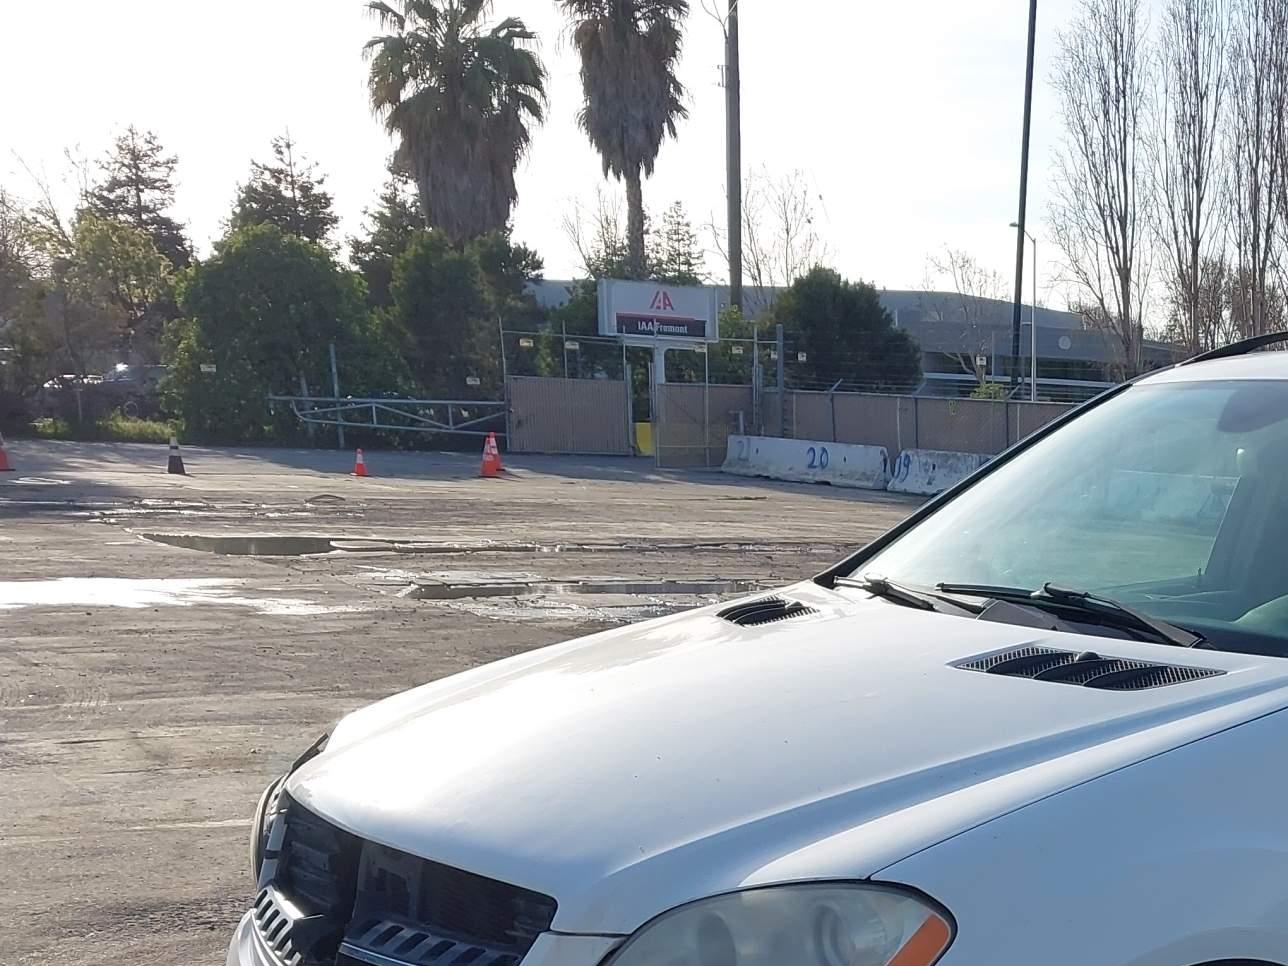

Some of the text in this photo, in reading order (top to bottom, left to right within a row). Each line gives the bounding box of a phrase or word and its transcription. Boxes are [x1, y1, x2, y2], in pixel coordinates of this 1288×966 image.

[638, 320, 688, 335] IAA Fremont
[806, 446, 829, 470] 20
